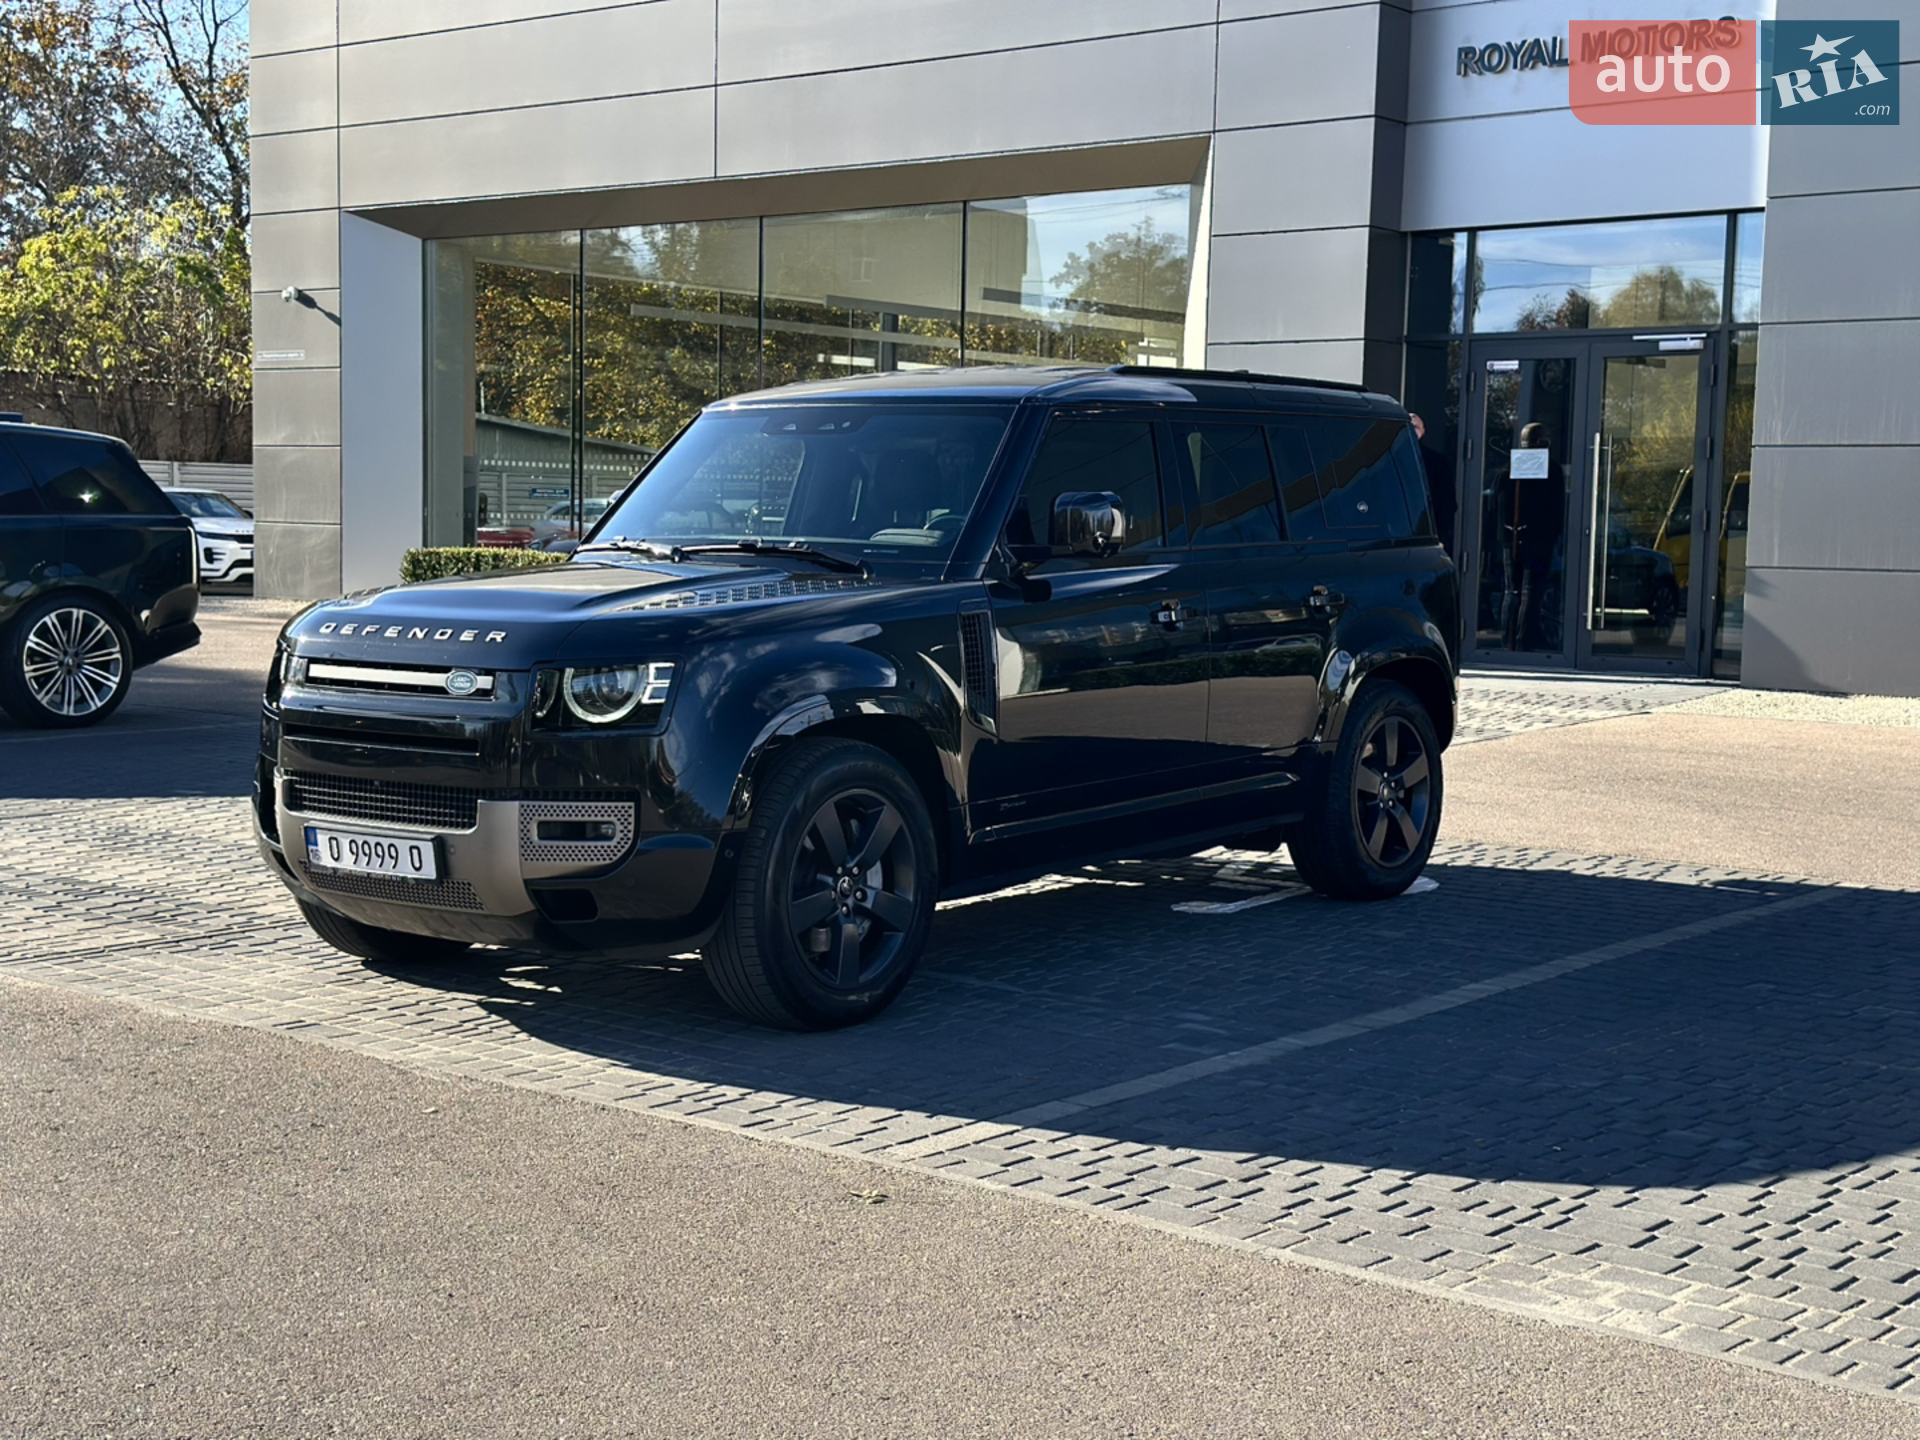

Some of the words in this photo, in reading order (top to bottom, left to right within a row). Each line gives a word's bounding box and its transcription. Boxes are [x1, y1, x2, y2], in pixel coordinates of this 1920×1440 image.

[1456, 36, 1570, 77] ROYAL
[1580, 16, 1741, 63] MOTORS
[319, 622, 507, 643] DEFENDER
[348, 839, 399, 870] 9999
